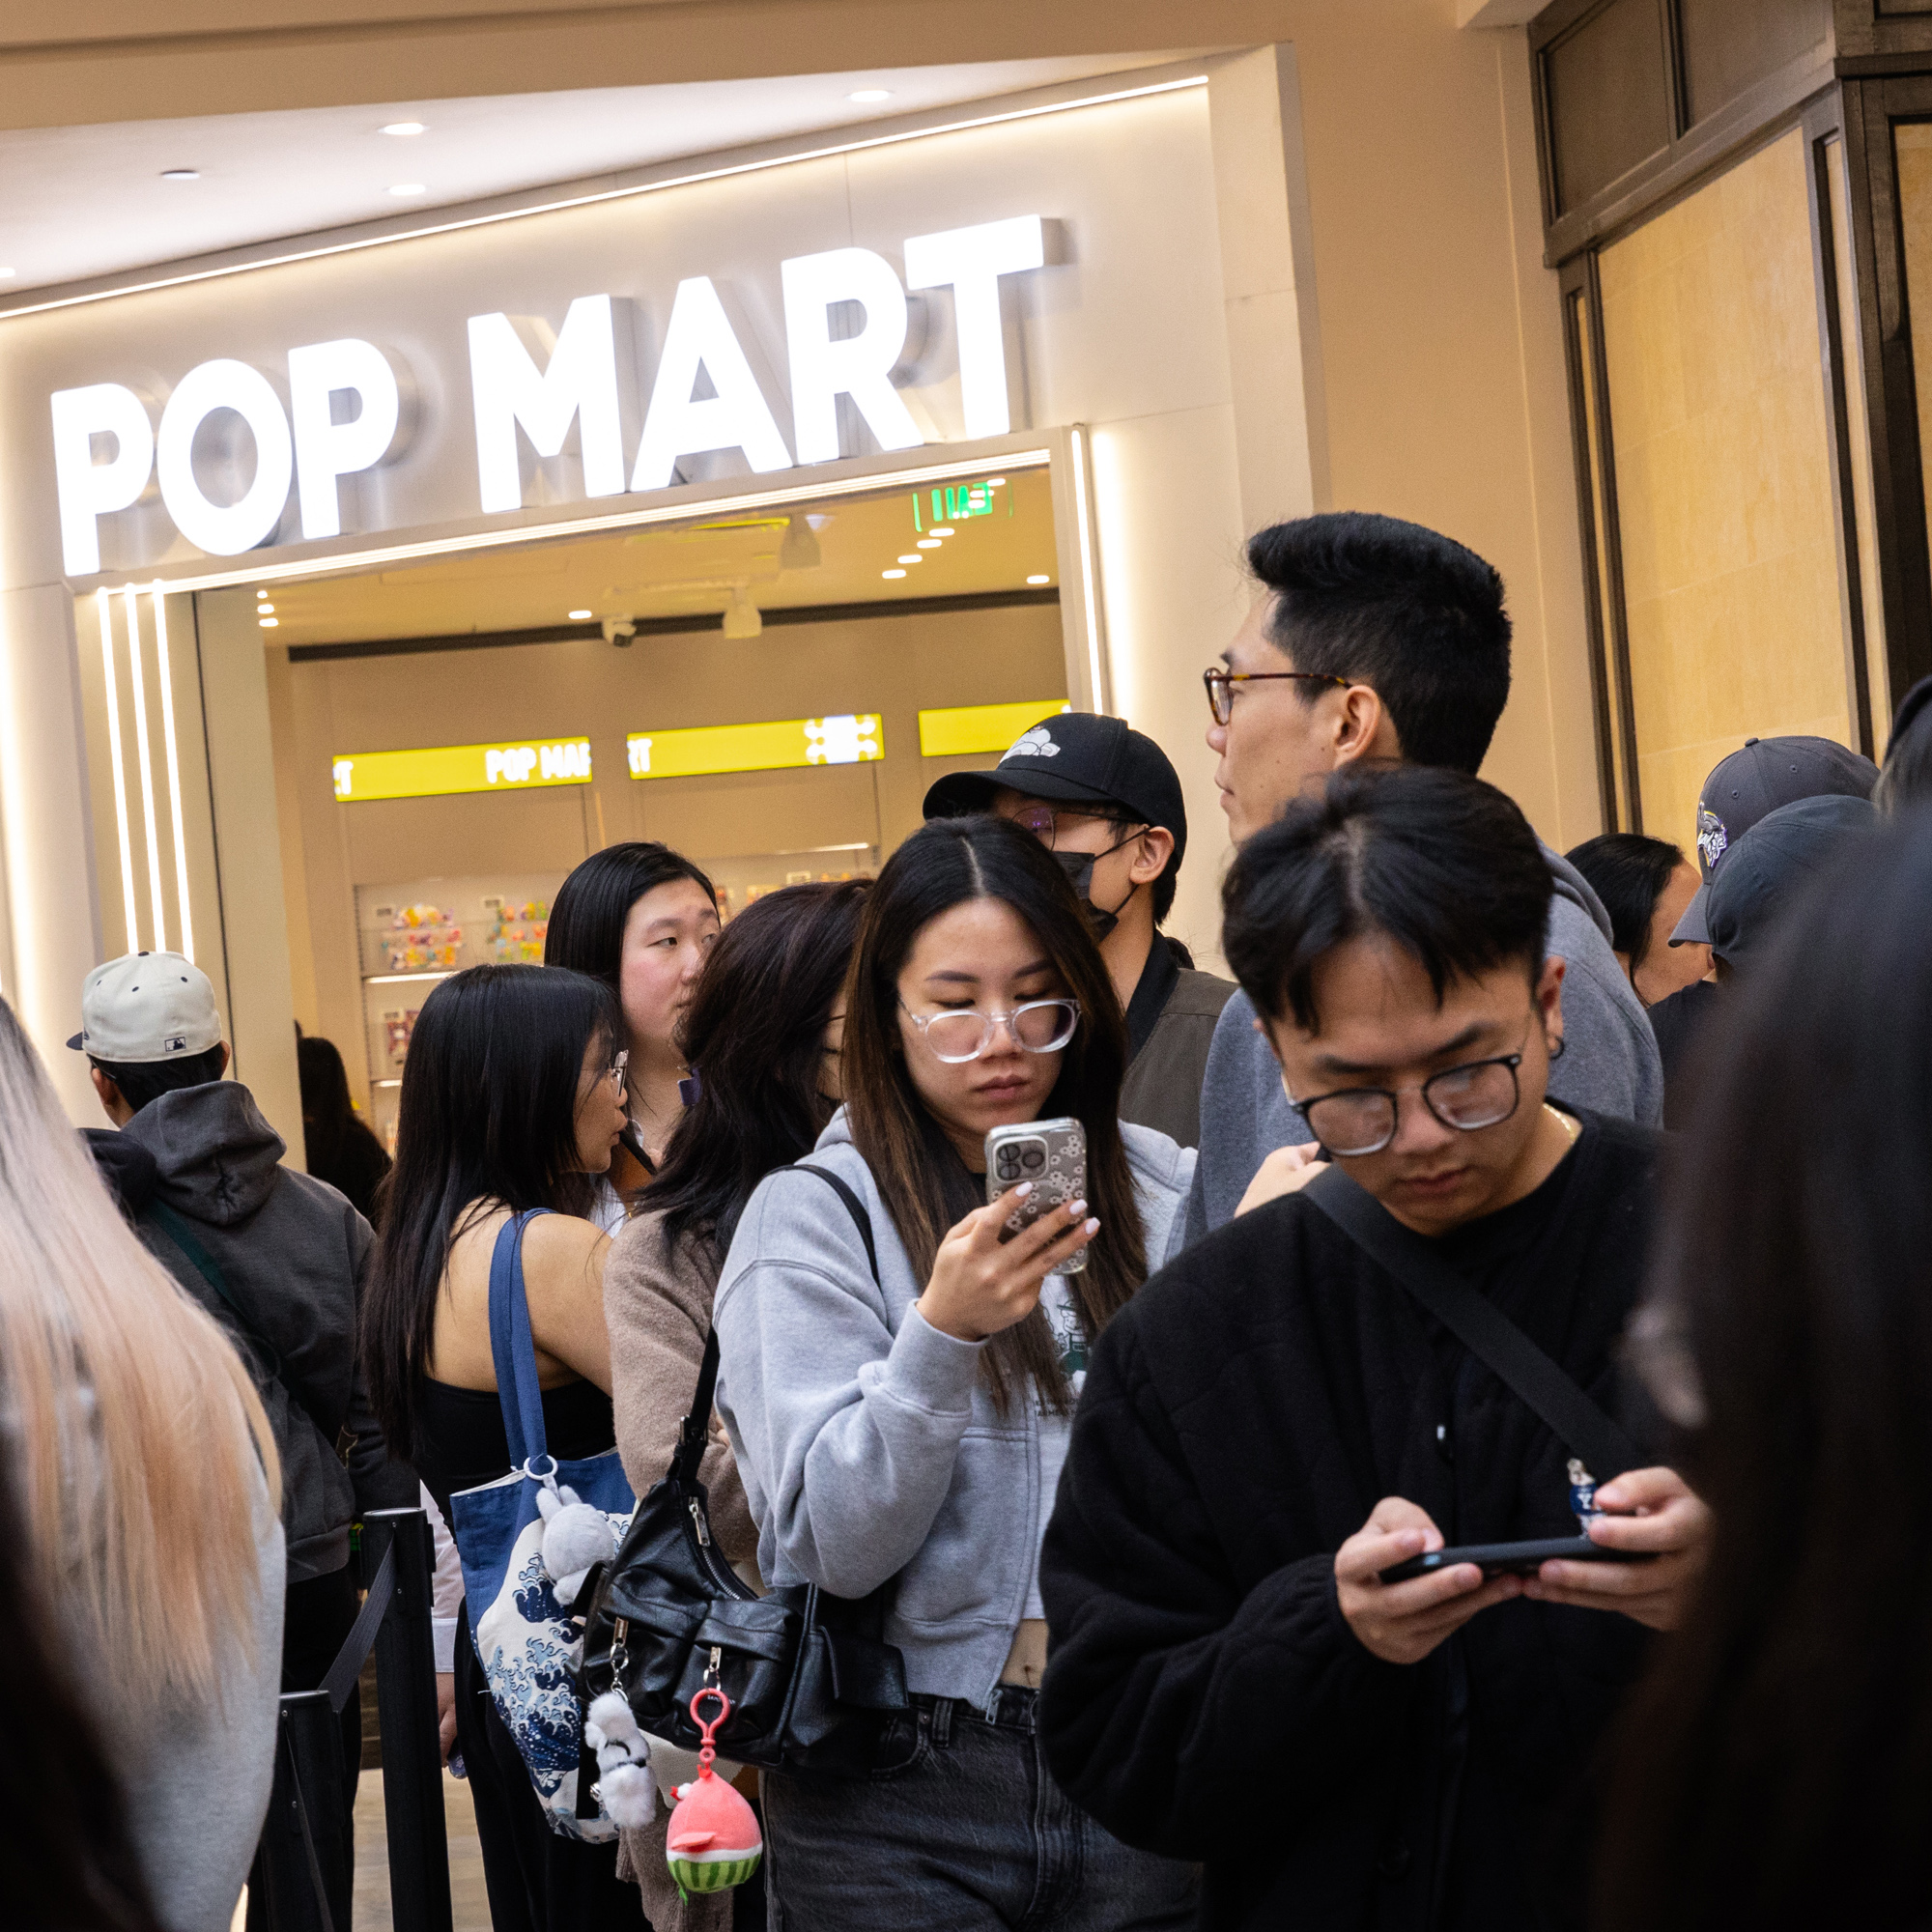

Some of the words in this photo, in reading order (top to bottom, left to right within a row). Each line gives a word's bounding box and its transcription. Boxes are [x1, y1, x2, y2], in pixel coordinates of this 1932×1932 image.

[50, 338, 399, 578] POP
[468, 214, 1045, 514] MART
[486, 747, 537, 783] POP
